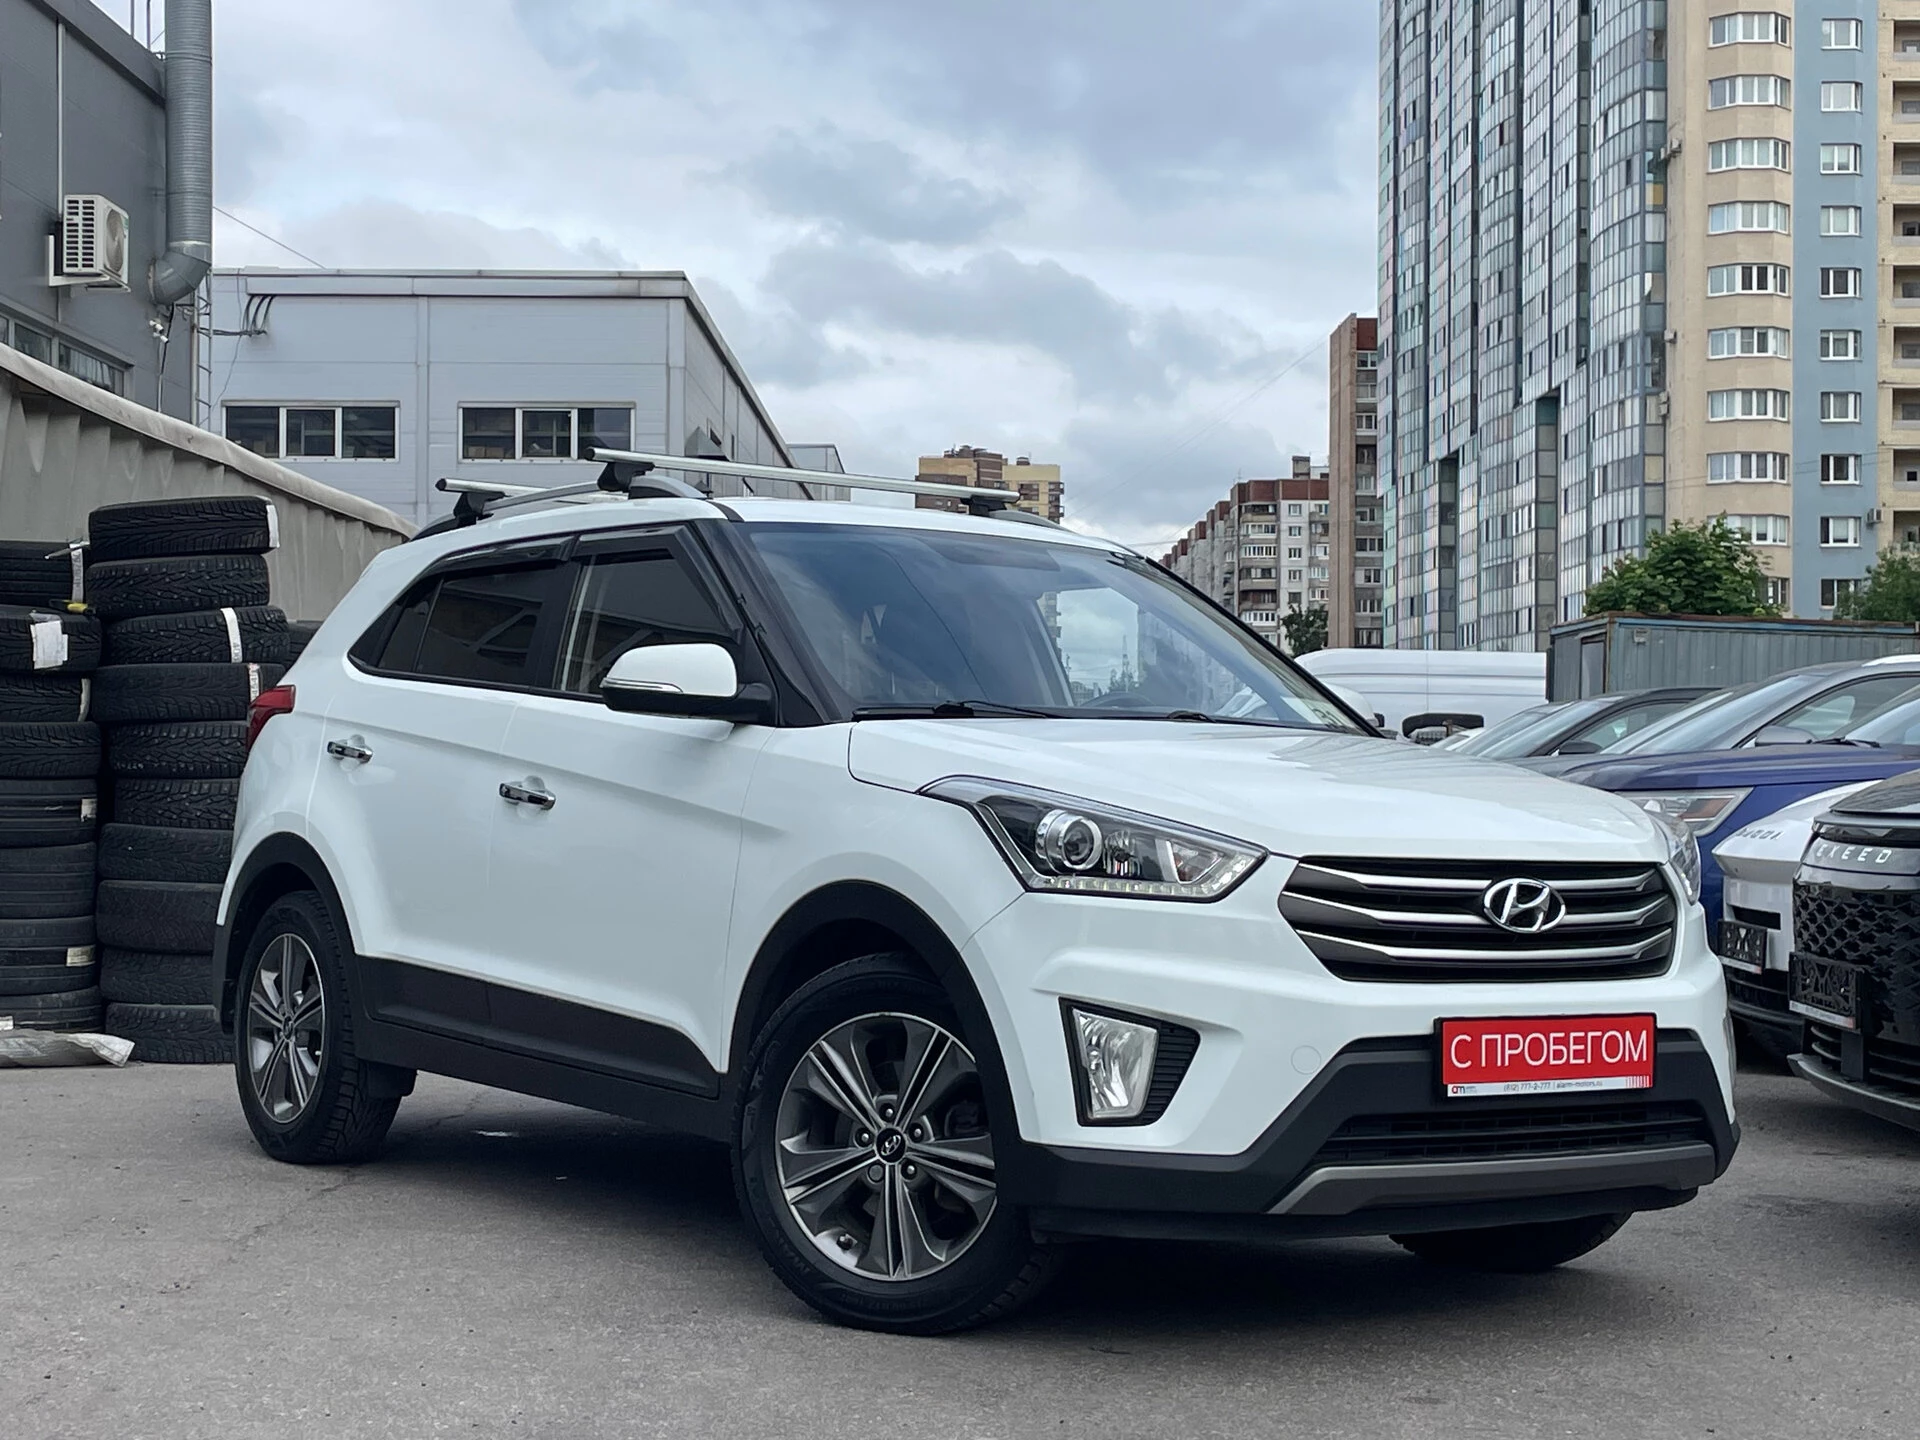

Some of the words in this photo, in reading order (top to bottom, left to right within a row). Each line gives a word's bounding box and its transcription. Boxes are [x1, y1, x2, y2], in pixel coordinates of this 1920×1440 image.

[1816, 843, 1893, 863] EXEED
[1450, 1034, 1472, 1068] С
[1481, 1029, 1648, 1068] ПРОБЕГОМ
